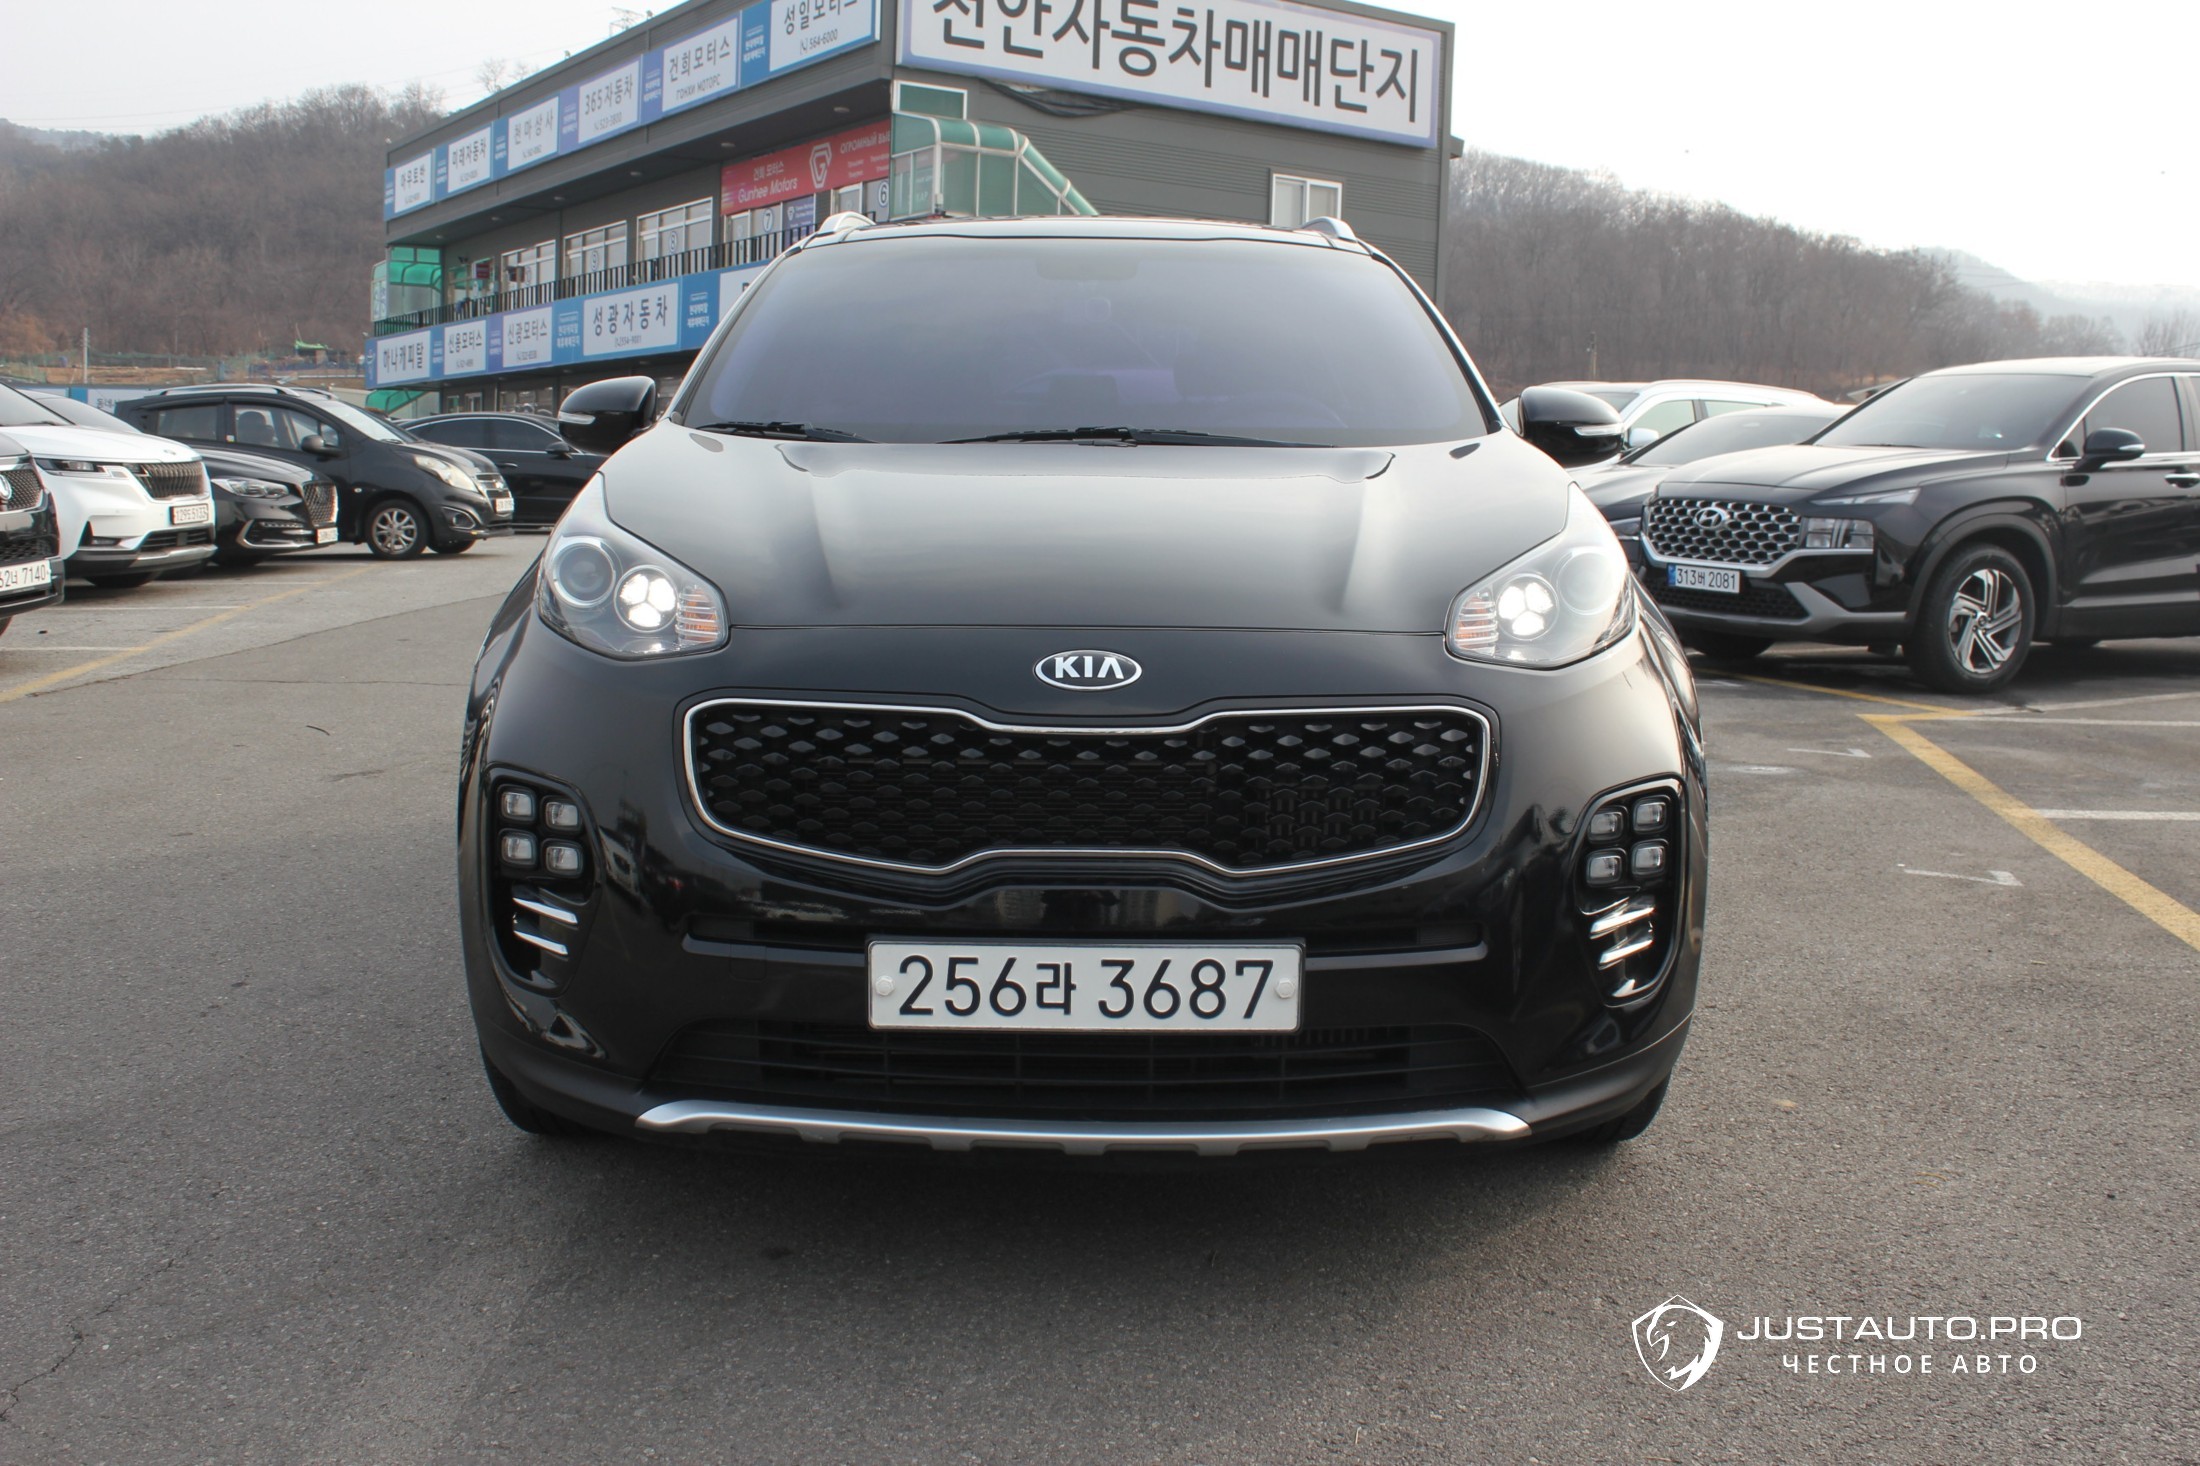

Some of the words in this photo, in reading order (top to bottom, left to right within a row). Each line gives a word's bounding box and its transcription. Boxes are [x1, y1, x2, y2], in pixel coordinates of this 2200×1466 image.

[784, 0, 858, 35] 성일모터
[669, 36, 731, 82] 건희모터스
[585, 73, 633, 115] 365자동차
[840, 132, 877, 154] ОГРОМНЫЙ
[766, 161, 784, 176] 모터스
[738, 184, 768, 203] Gunhee
[770, 177, 798, 197] Motors
[593, 294, 668, 337] 성광자동차
[507, 317, 548, 345] 신광모터스
[383, 341, 424, 373] 하나캐피탈
[22, 564, 46, 585] 7140
[1708, 571, 1736, 590] 2081
[1054, 656, 1125, 680] KIA
[899, 955, 1077, 1017] 256라
[1098, 958, 1275, 1020] 3687
